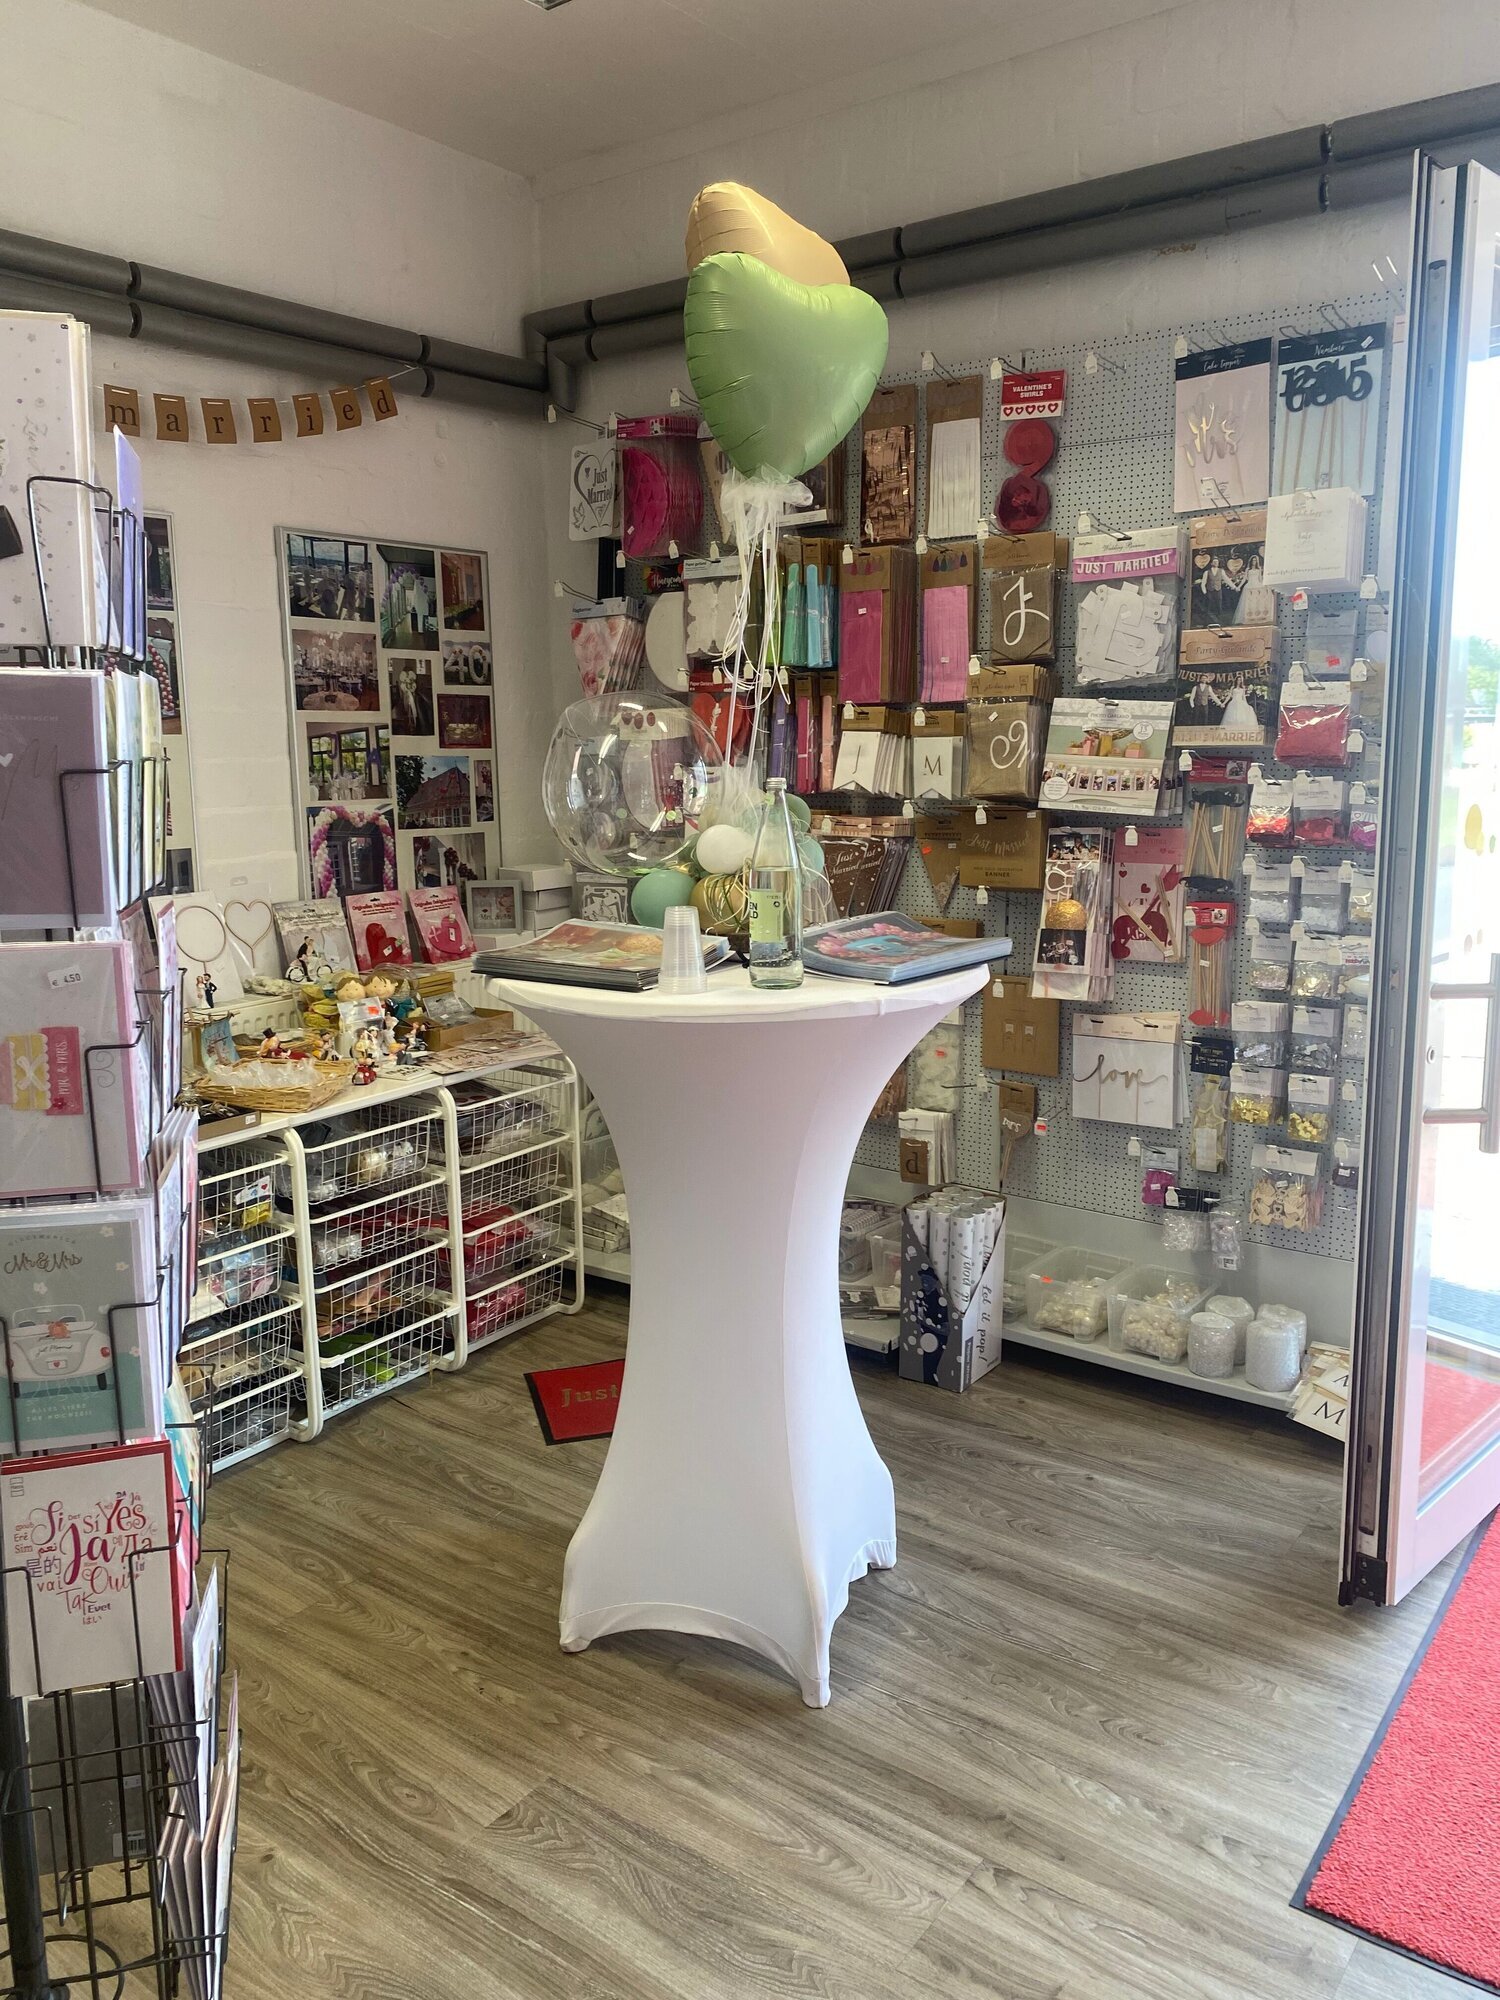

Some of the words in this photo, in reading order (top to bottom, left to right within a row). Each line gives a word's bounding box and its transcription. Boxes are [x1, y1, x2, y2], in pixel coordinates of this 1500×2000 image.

[1013, 383, 1052, 392] VALENTINE'S
[1020, 390, 1044, 398] SWIRLS
[109, 389, 392, 434] married
[592, 468, 608, 487] Just
[1077, 562, 1107, 574] JUST
[1114, 552, 1171, 573] MARRIED
[1177, 669, 1202, 682] JUST
[1216, 664, 1273, 683] MARRIED
[852, 745, 862, 775] J
[922, 755, 943, 776] M
[1072, 1054, 1168, 1088] love
[905, 1151, 920, 1175] d
[561, 1385, 618, 1408] Just
[1312, 1401, 1347, 1427] M
[95, 1499, 147, 1535] Yes
[26, 1555, 61, 1577] 是的
[59, 1523, 117, 1585] Ja
[82, 1565, 129, 1594] Oui
[56, 1587, 97, 1615] Tak
